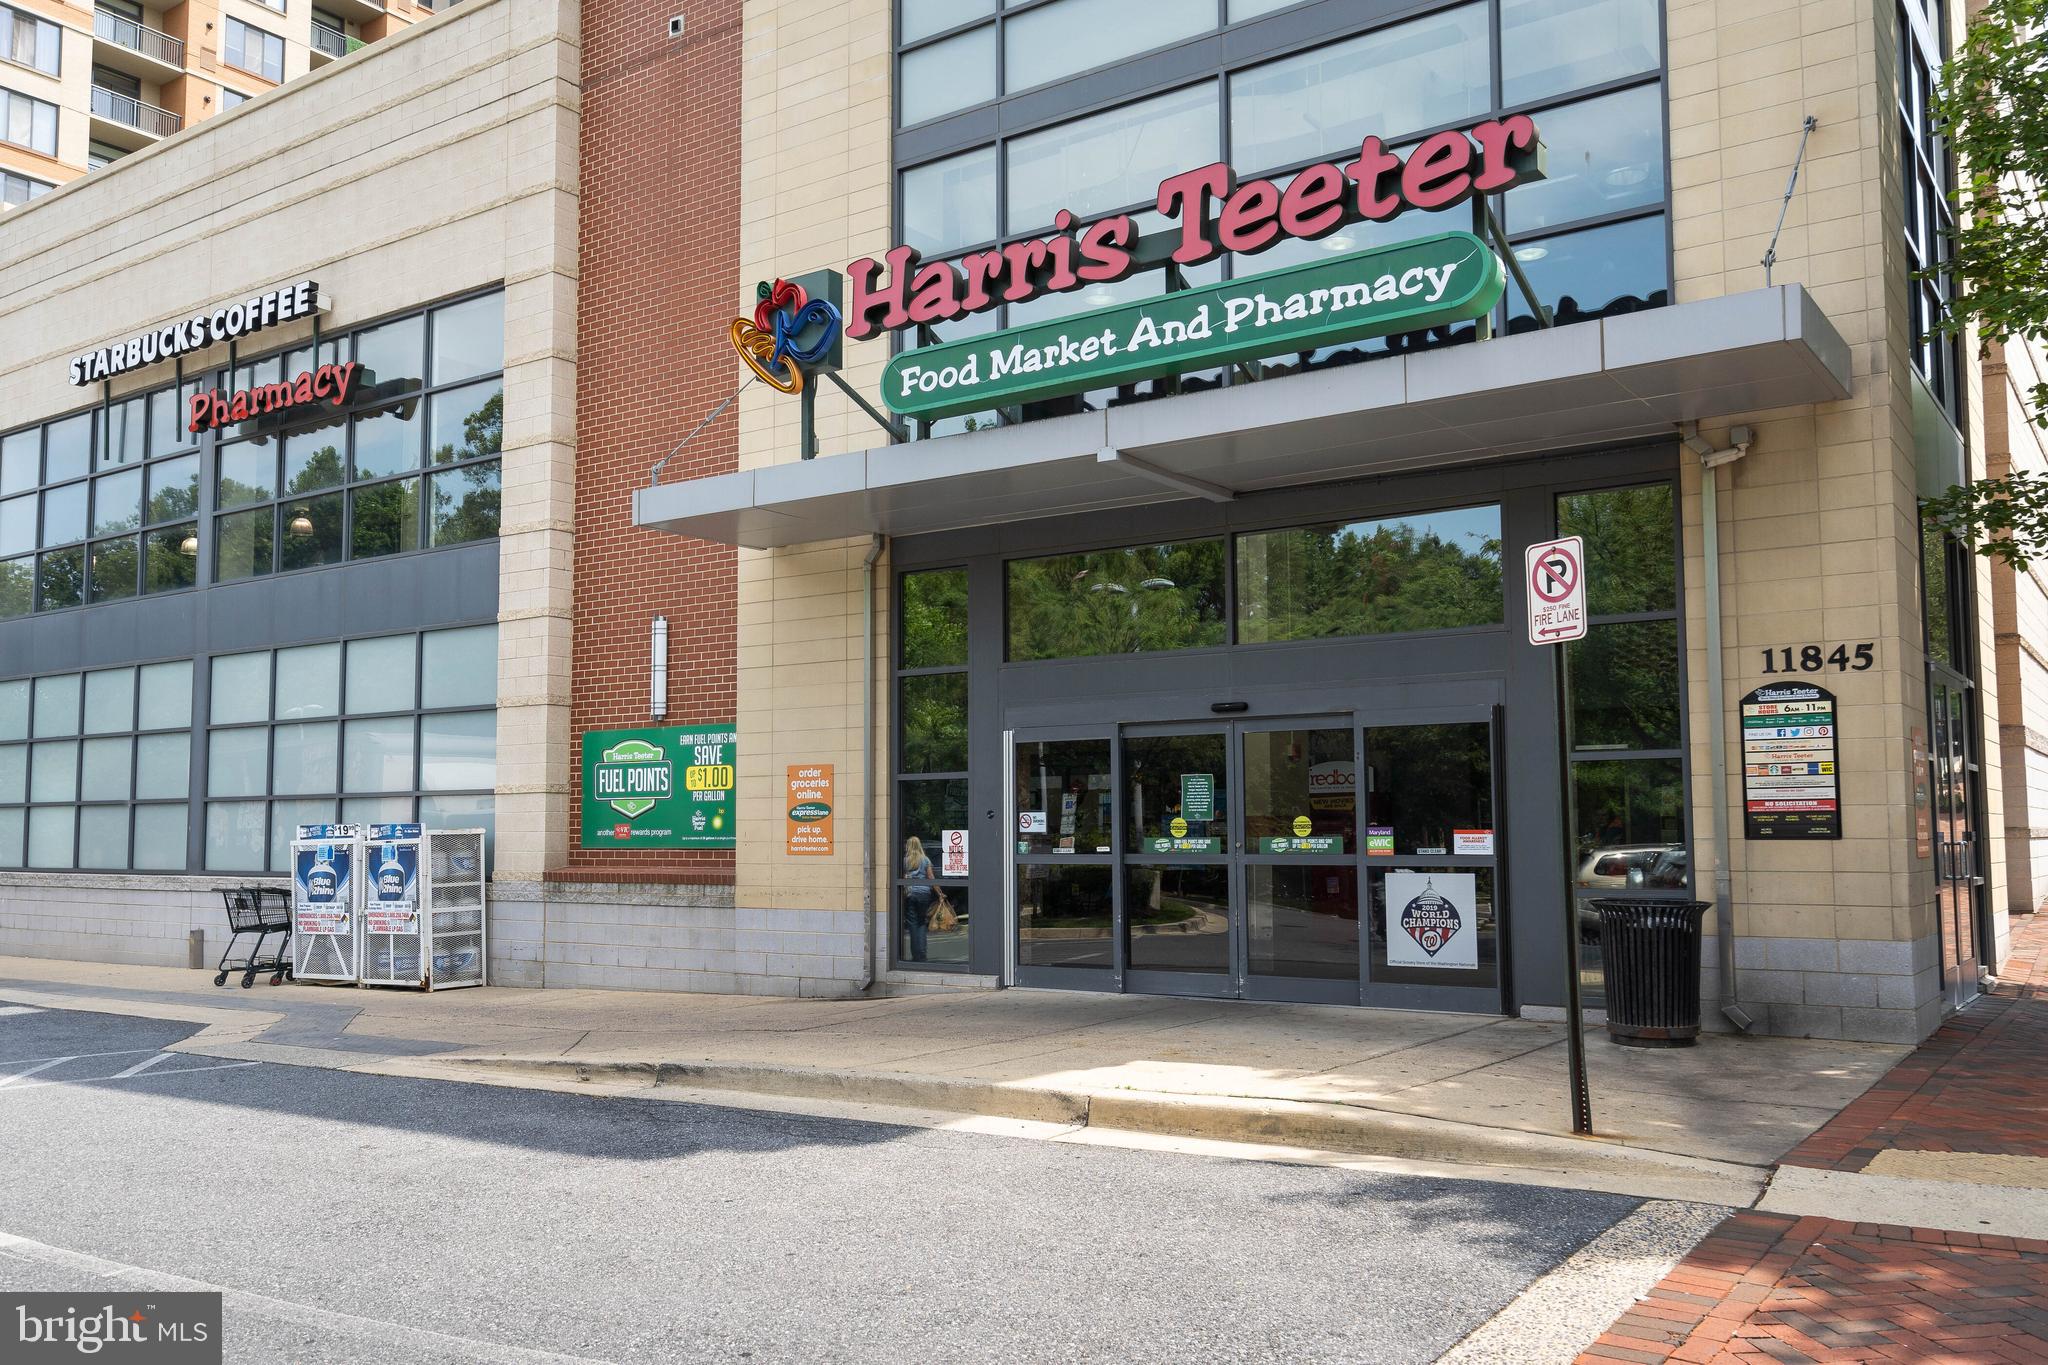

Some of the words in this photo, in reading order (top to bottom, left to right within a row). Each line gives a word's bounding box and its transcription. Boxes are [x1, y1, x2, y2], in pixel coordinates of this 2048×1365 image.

[845, 208, 1136, 341] Harris
[1157, 114, 1539, 266] Teeter
[68, 315, 207, 387] STARBUCKS
[210, 280, 317, 342] COFFEE
[900, 353, 980, 397] Food
[988, 328, 1118, 380] Market
[1127, 306, 1213, 352] And
[1223, 262, 1458, 333] Pharmacy
[189, 361, 356, 433] Pharmacy
[1542, 605, 1556, 613] $250
[1534, 612, 1553, 626] FIRE
[1556, 608, 1580, 623] LANE
[1762, 642, 1874, 674] 11845
[680, 734, 694, 745] EARN
[694, 734, 706, 744] FUEL
[707, 733, 728, 744] POINTS
[728, 732, 737, 743] AN
[634, 752, 654, 760] Teeter
[694, 744, 723, 766] SAVE
[690, 770, 696, 778] UP
[698, 766, 728, 788] $1.00
[798, 768, 822, 778] order
[1310, 769, 1355, 786] redbo
[600, 769, 625, 792] FUEL
[628, 768, 668, 792] POINTS
[690, 780, 696, 788] TO
[791, 778, 829, 790] groceries
[692, 791, 702, 801] PER
[704, 790, 724, 801] GALLON
[796, 790, 823, 799] online.
[651, 828, 672, 837] program
[797, 825, 811, 834] pick
[1369, 838, 1391, 847] eWIC
[313, 878, 331, 886] Blue
[383, 875, 400, 884] Blue
[1412, 909, 1449, 918] WORLD
[1402, 918, 1459, 930] CHAMPIONS
